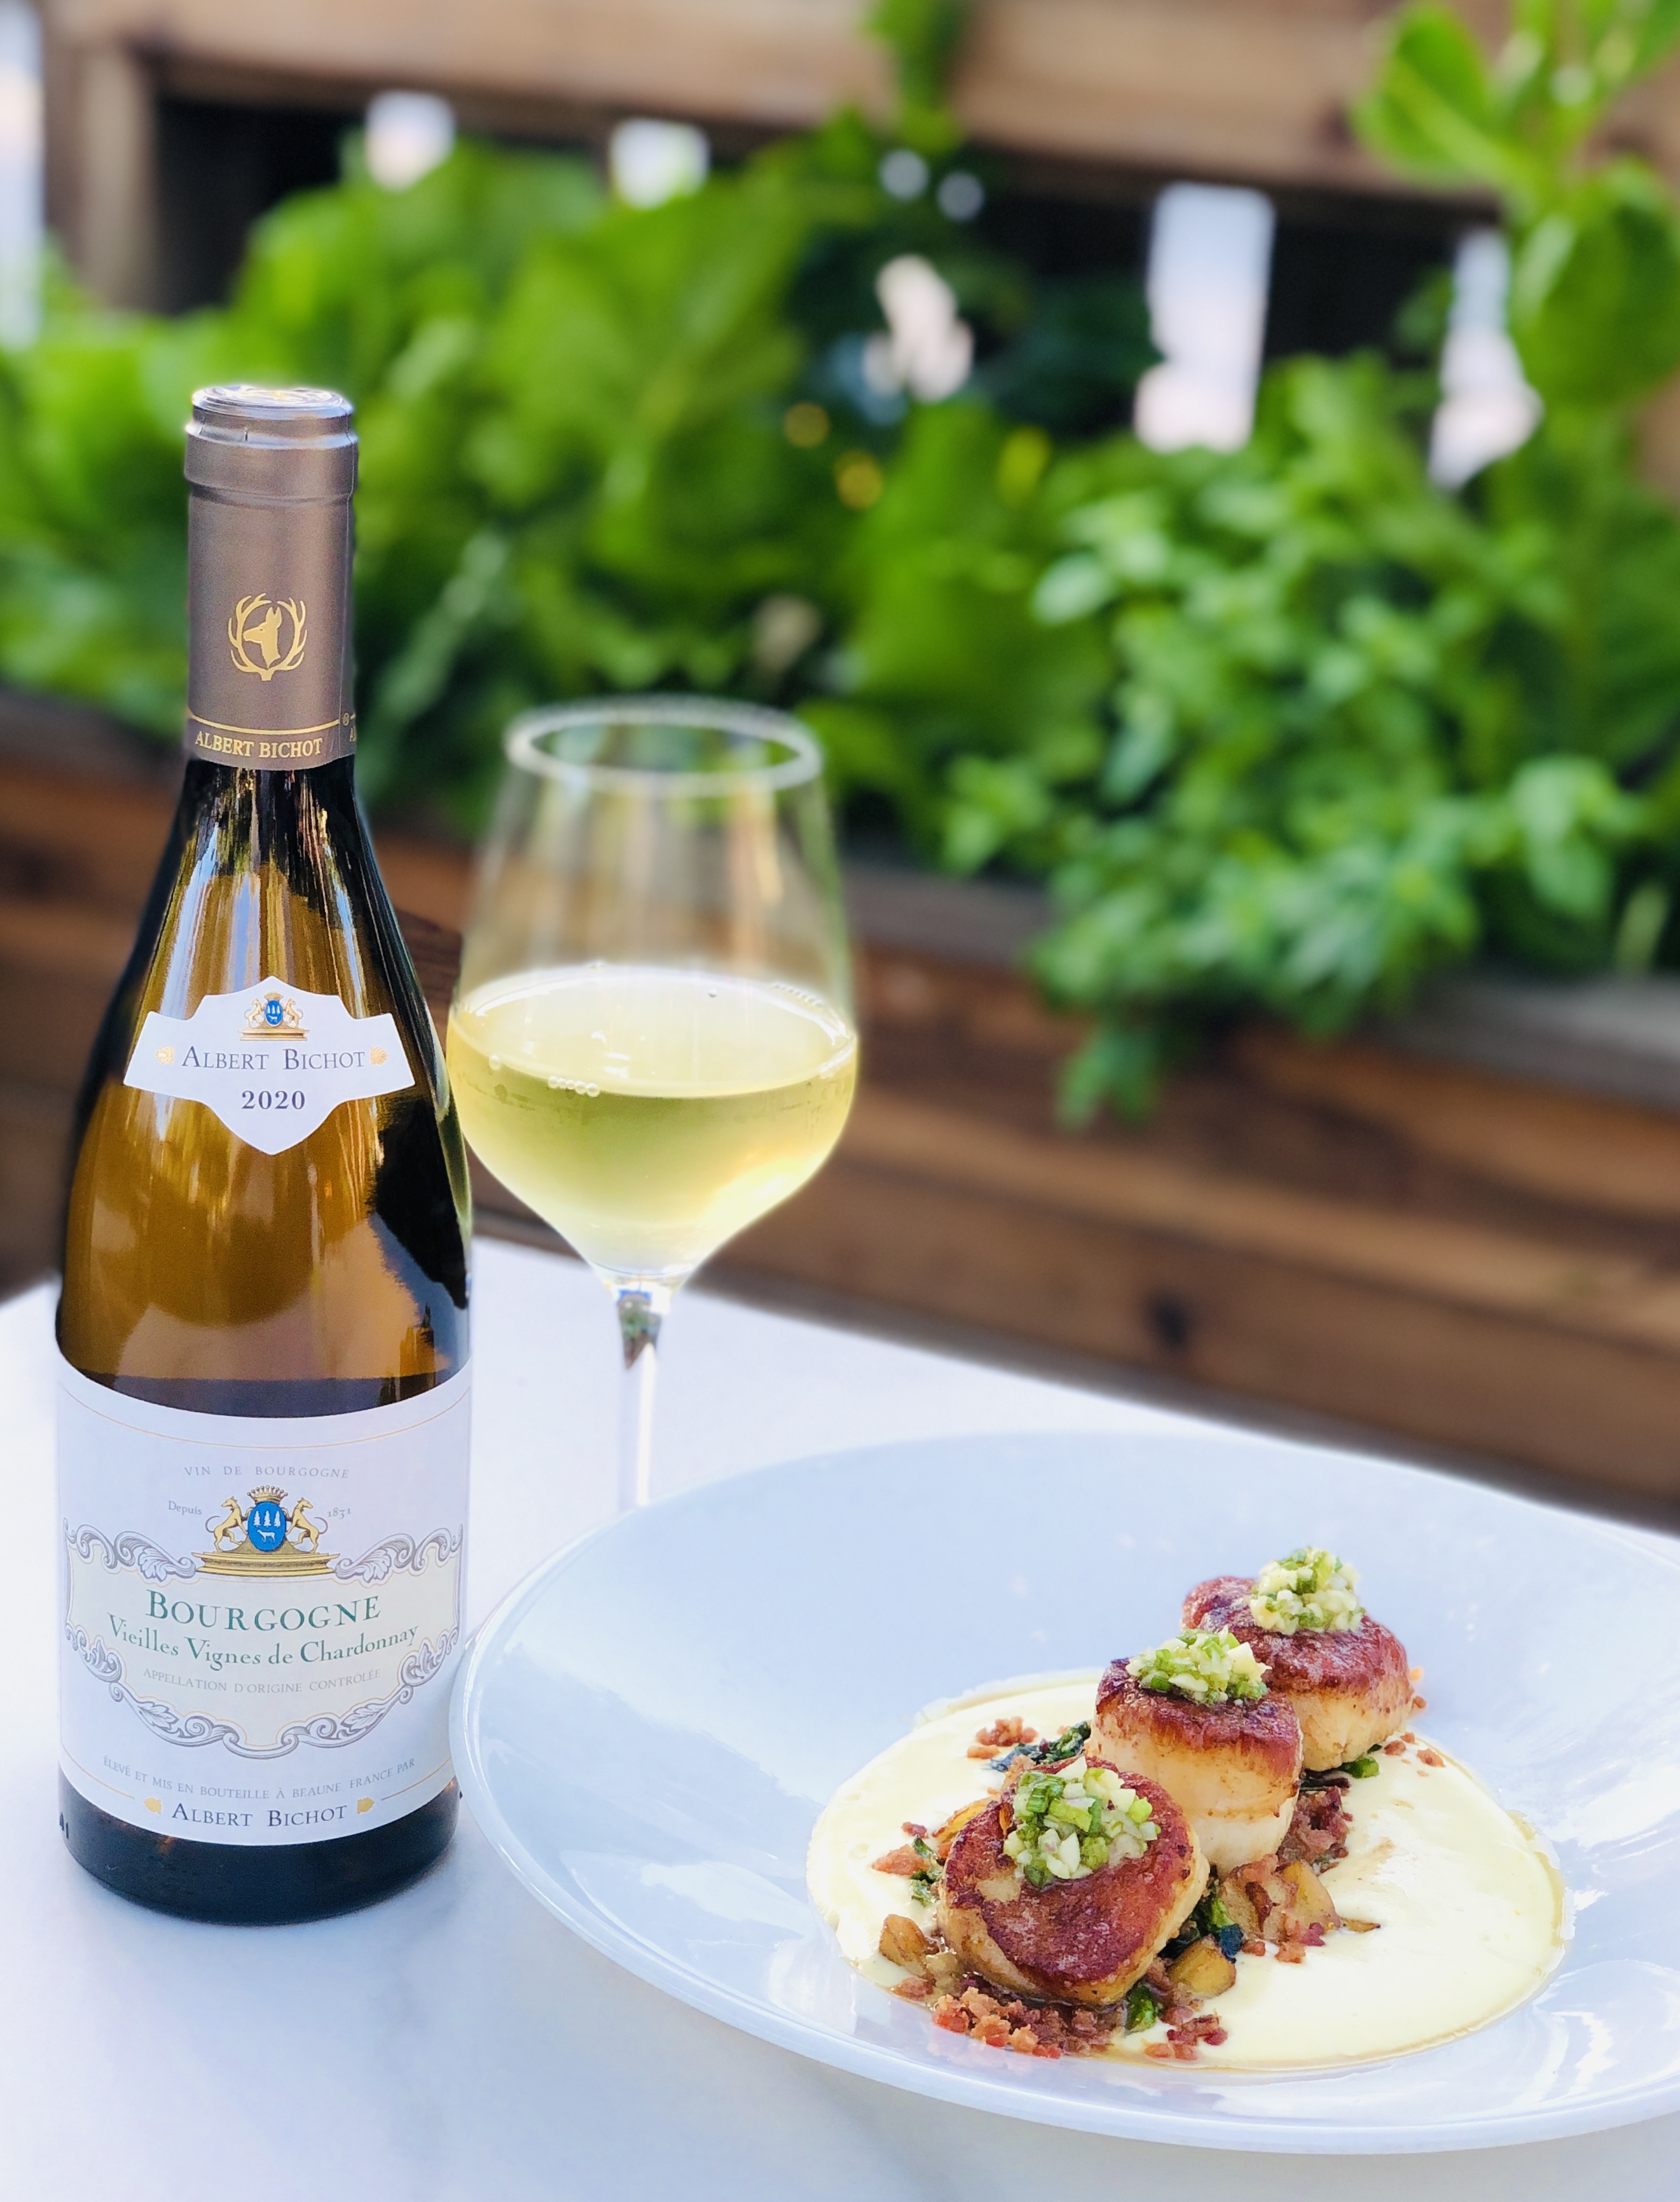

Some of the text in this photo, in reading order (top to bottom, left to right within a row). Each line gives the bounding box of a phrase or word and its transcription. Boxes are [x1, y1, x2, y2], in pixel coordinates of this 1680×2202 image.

[195, 730, 323, 759] ALBERT BICHOT
[181, 1046, 366, 1070] ALBERT BICHOT
[241, 1090, 306, 1110] 2020
[184, 1465, 350, 1479] VIN DE BOURGOGNE
[167, 1500, 351, 1520] Depuis 1831
[145, 1589, 382, 1631] BOURGOGNE
[107, 1612, 420, 1672] Vieilles Vignes de Chardonnay
[143, 1668, 227, 1692] APPELLATION
[103, 1754, 131, 1777] ÉLEVÉ
[134, 1770, 148, 1783] ET
[153, 1776, 173, 1790] MIS
[177, 1782, 194, 1794] EN
[200, 1785, 270, 1799] BOUTEILLE
[275, 1787, 285, 1799] À
[350, 1768, 394, 1789] FRANCE
[397, 1757, 415, 1774] PAR
[171, 1803, 348, 1827] ALBERT BICHOT
